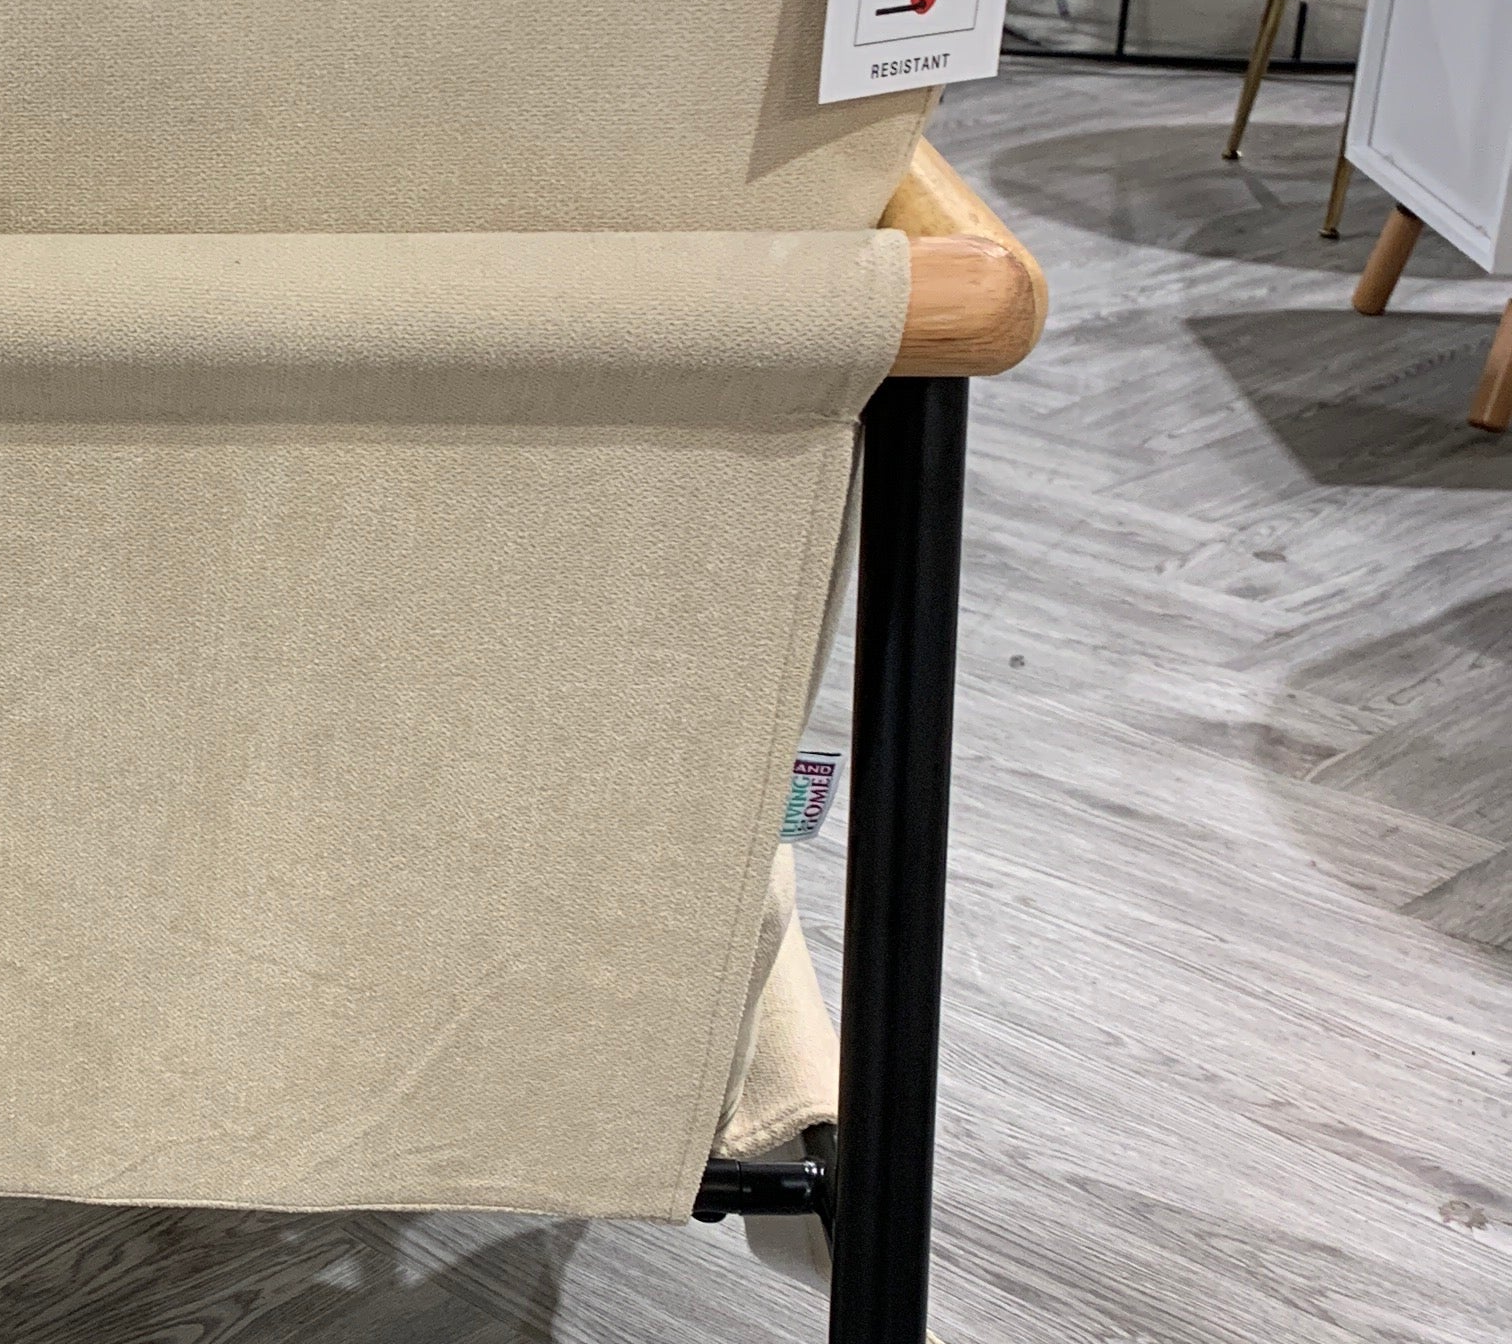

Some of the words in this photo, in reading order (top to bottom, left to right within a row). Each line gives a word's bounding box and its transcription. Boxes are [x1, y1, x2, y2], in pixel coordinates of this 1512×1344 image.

[871, 53, 950, 79] RESISTANT
[796, 764, 832, 774] AND
[781, 776, 810, 832] LIVING
